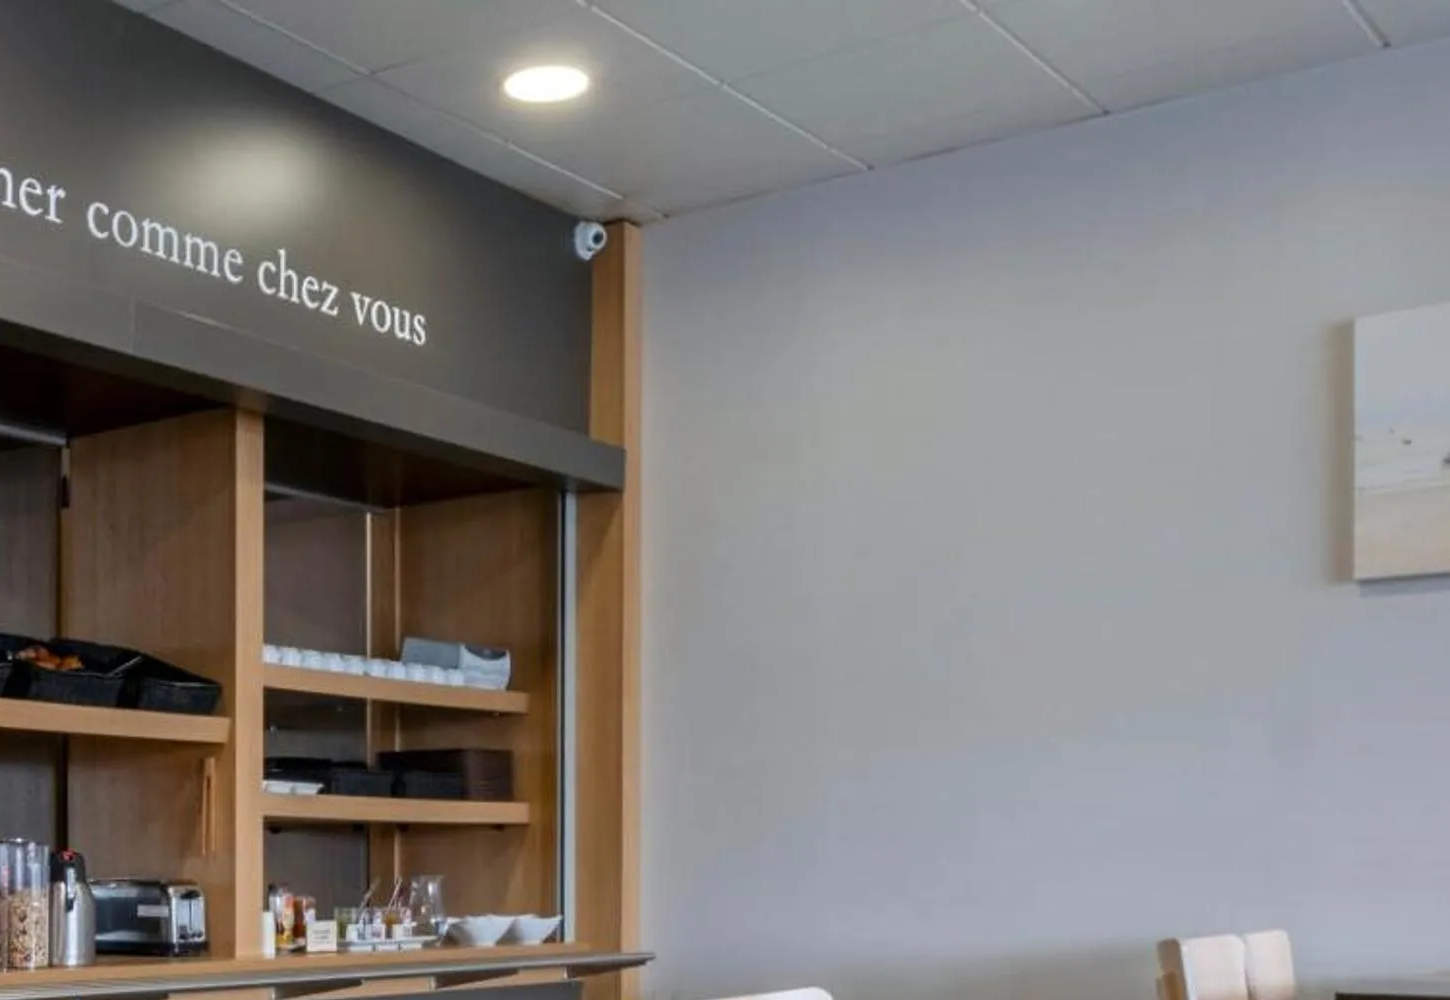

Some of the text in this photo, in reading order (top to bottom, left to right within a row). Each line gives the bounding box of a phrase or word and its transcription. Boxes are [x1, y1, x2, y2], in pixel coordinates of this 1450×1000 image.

[87, 202, 244, 284] comme
[258, 249, 339, 317] chez
[351, 292, 427, 345] vous
